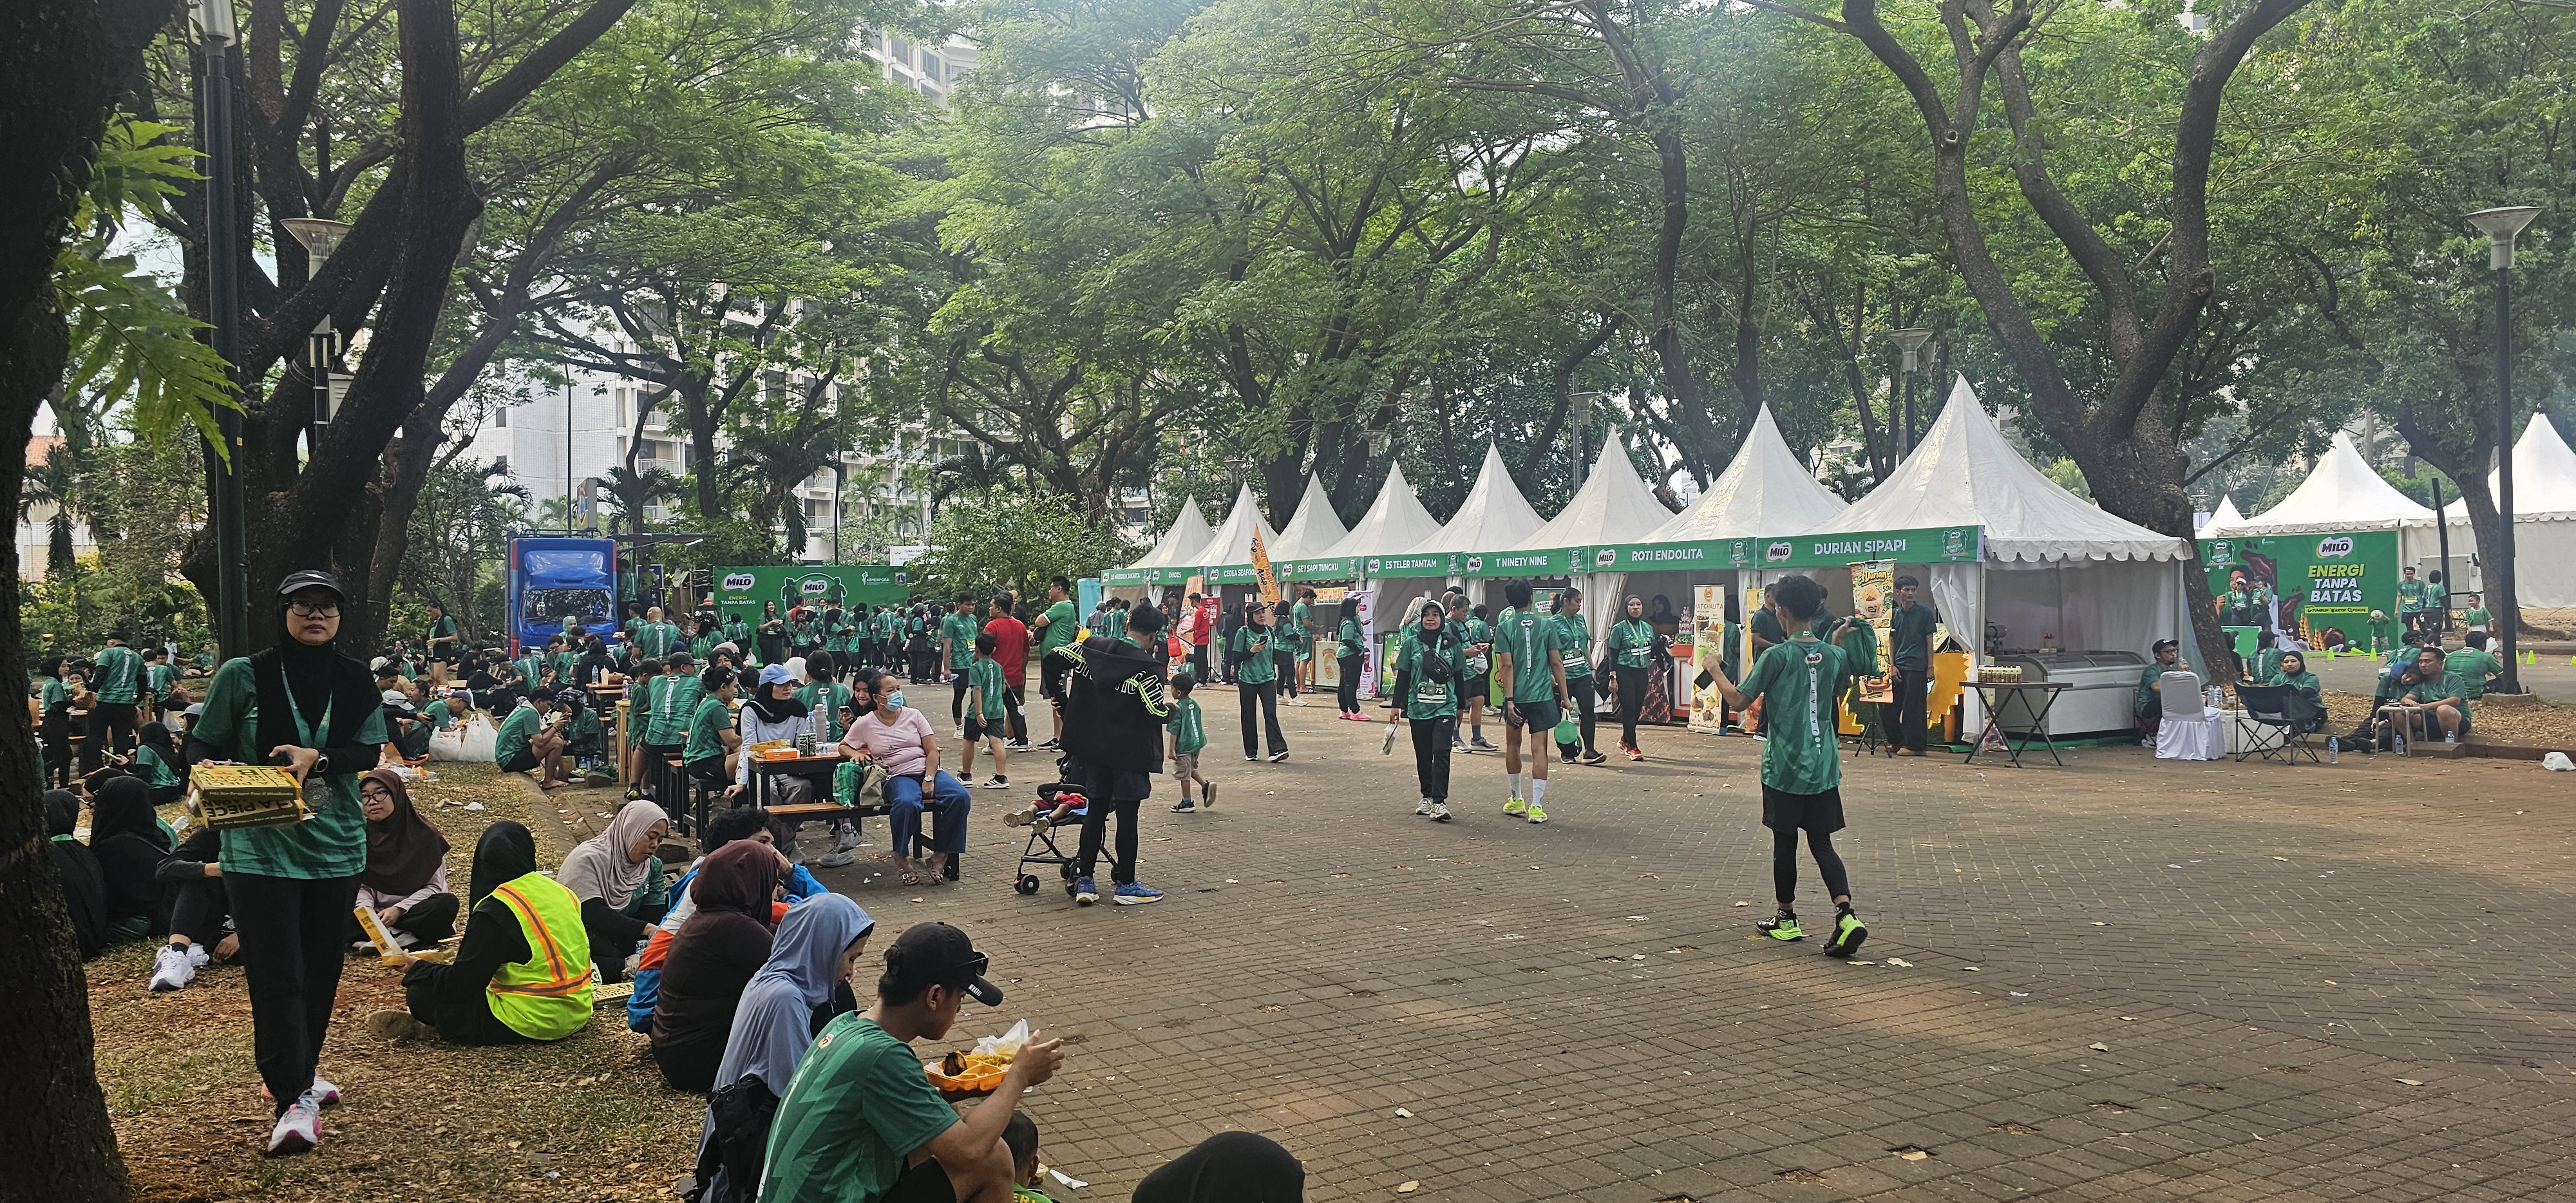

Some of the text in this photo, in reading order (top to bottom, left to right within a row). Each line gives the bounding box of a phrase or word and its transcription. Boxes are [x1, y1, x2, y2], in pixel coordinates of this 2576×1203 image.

[1770, 547, 1789, 557] MILO
[1815, 539, 1906, 554] DURIAN SIPAPI
[2322, 543, 2349, 553] MILO
[1598, 554, 1614, 562] MILO
[1632, 549, 1703, 561] ROTI ENDOLITA
[1318, 563, 1339, 571] TUNGKU
[1393, 560, 1410, 569] TELER
[1411, 559, 1437, 568] TAMTAM
[1496, 556, 1547, 567] T NINETY NINE
[1864, 570, 1888, 582] Durian
[2308, 564, 2365, 578] ENERGI
[726, 578, 752, 587] MILO
[2315, 578, 2357, 589] TANPA
[2310, 589, 2362, 602] BATAS
[205, 802, 256, 818] PIECE
